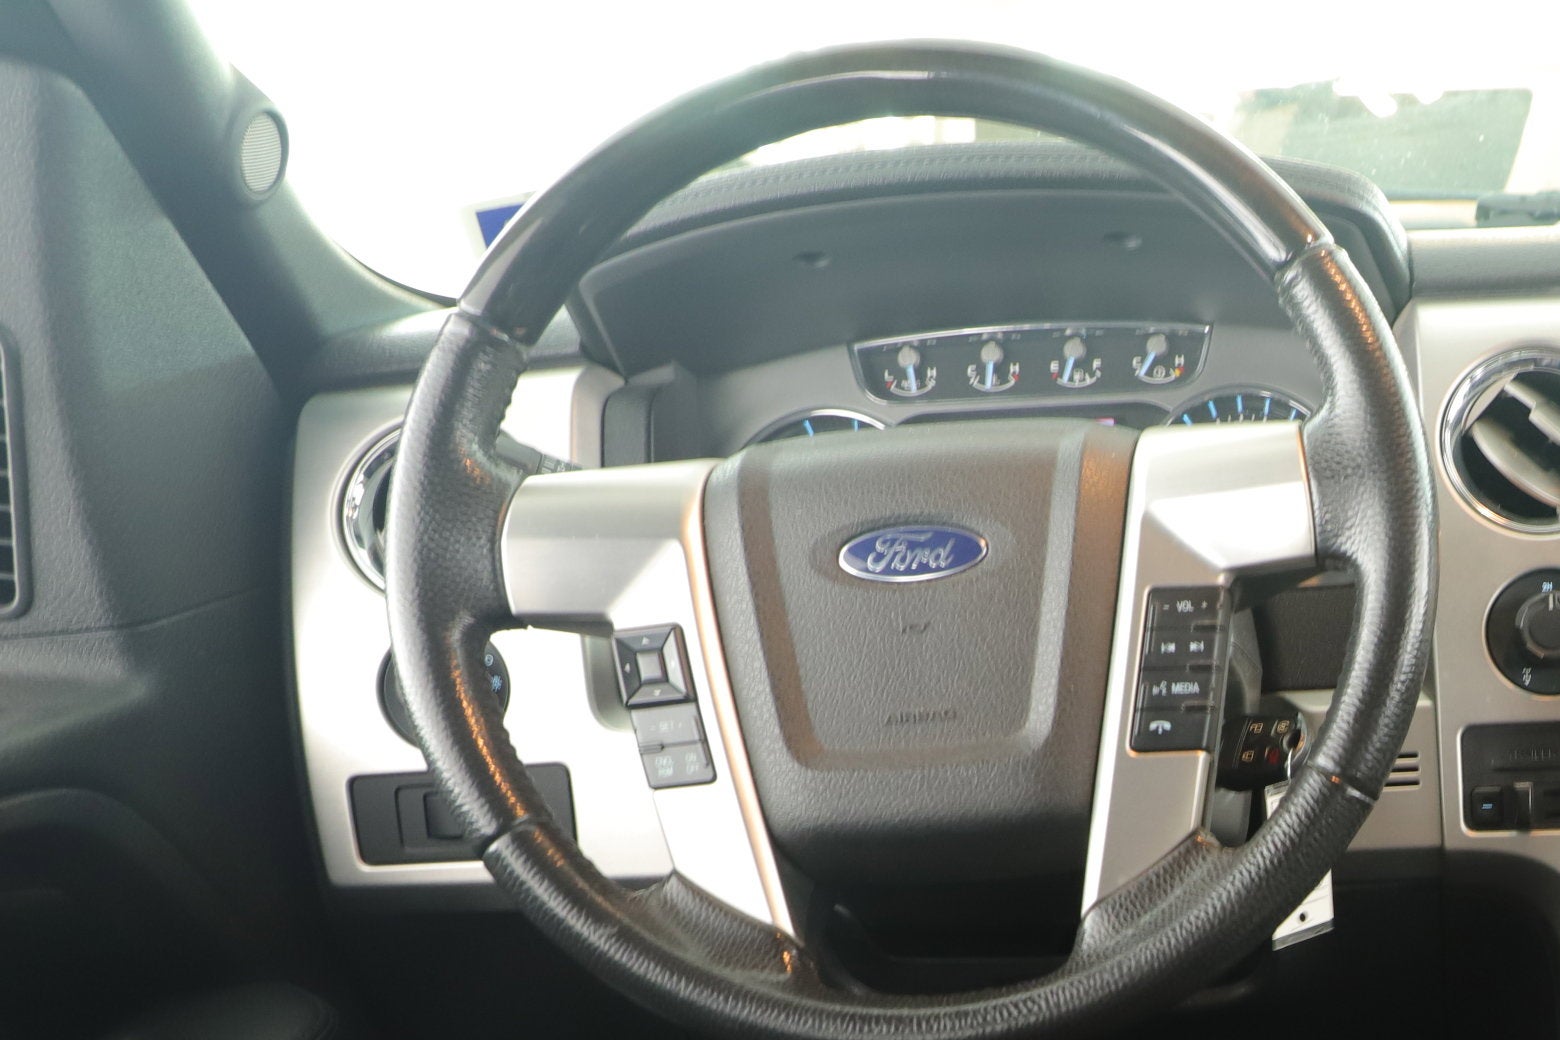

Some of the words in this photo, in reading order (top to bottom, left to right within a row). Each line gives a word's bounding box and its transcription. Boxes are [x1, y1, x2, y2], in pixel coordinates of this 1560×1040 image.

[867, 531, 955, 573] Ford
[1176, 600, 1194, 613] VOL
[1171, 682, 1200, 695] MEDIA
